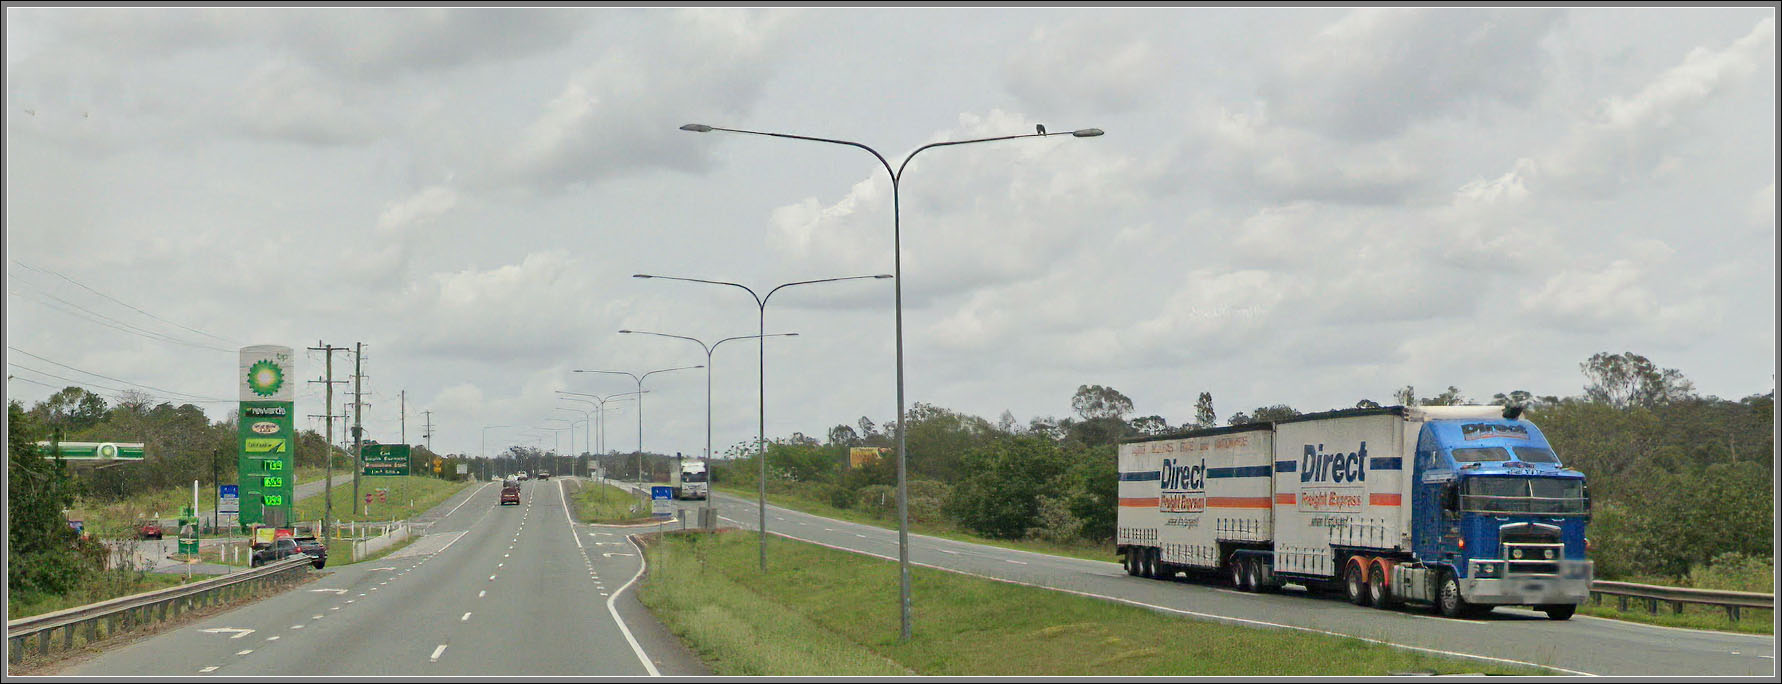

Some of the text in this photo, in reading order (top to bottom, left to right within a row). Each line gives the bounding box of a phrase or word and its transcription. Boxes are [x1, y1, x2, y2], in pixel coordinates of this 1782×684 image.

[1461, 422, 1529, 434] Direct
[1161, 458, 1205, 489] Direct
[1301, 441, 1367, 483] Direct
